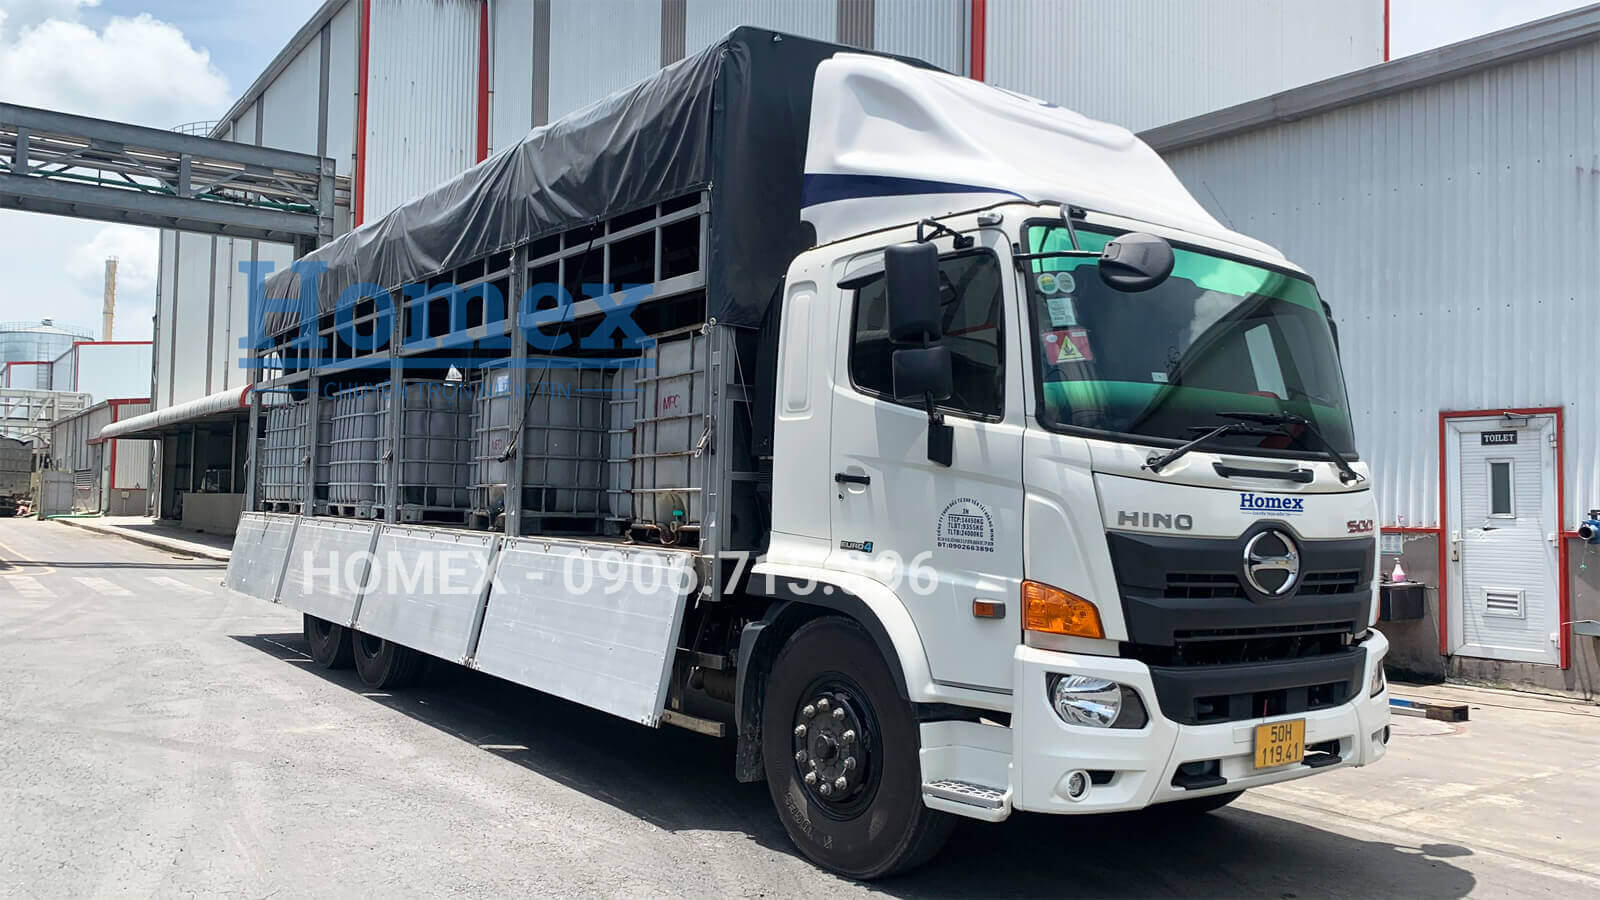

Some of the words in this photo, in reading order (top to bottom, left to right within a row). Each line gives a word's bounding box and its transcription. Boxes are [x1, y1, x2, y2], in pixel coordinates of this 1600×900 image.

[1483, 433, 1514, 442] TOILET
[1240, 493, 1304, 509] Homex
[1118, 511, 1193, 530] HINO
[1271, 724, 1292, 743] 50H
[1262, 742, 1298, 765] 119.41
